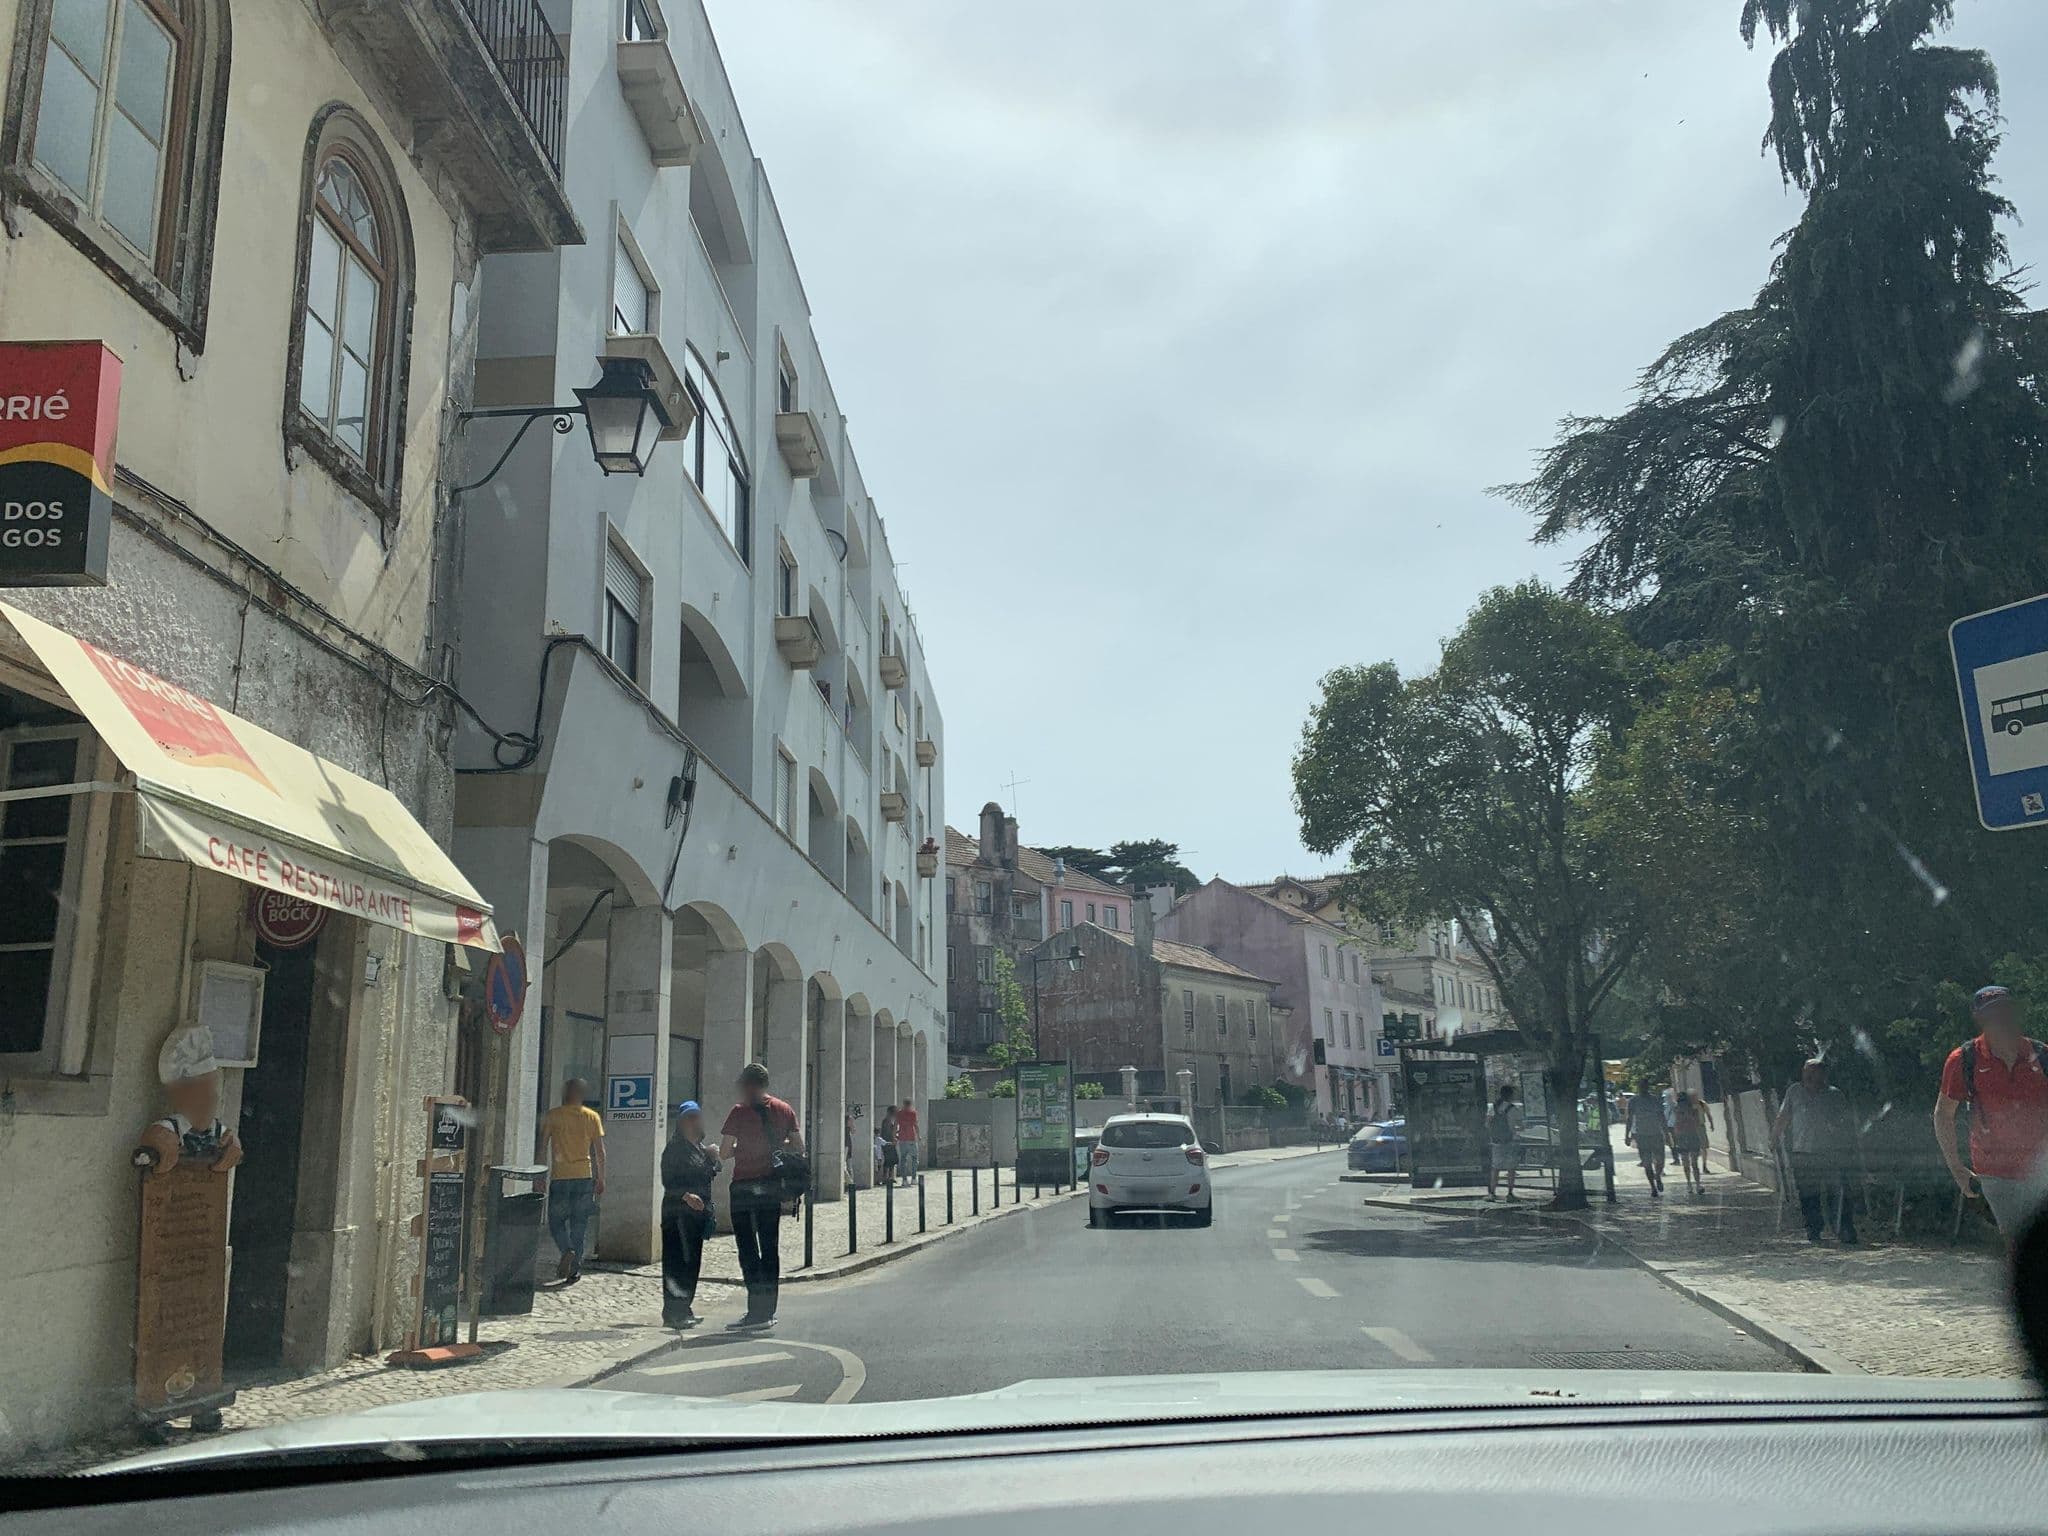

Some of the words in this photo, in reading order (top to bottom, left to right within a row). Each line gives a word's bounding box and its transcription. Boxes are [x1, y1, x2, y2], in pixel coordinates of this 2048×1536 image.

[4, 501, 64, 521] DOS
[2, 528, 62, 547] GOS
[208, 836, 269, 881] CAFÉ
[280, 859, 413, 925] RESTAURANTE
[268, 907, 311, 922] BOCK
[613, 1080, 637, 1107] P
[613, 1112, 647, 1120] PRIVADO
